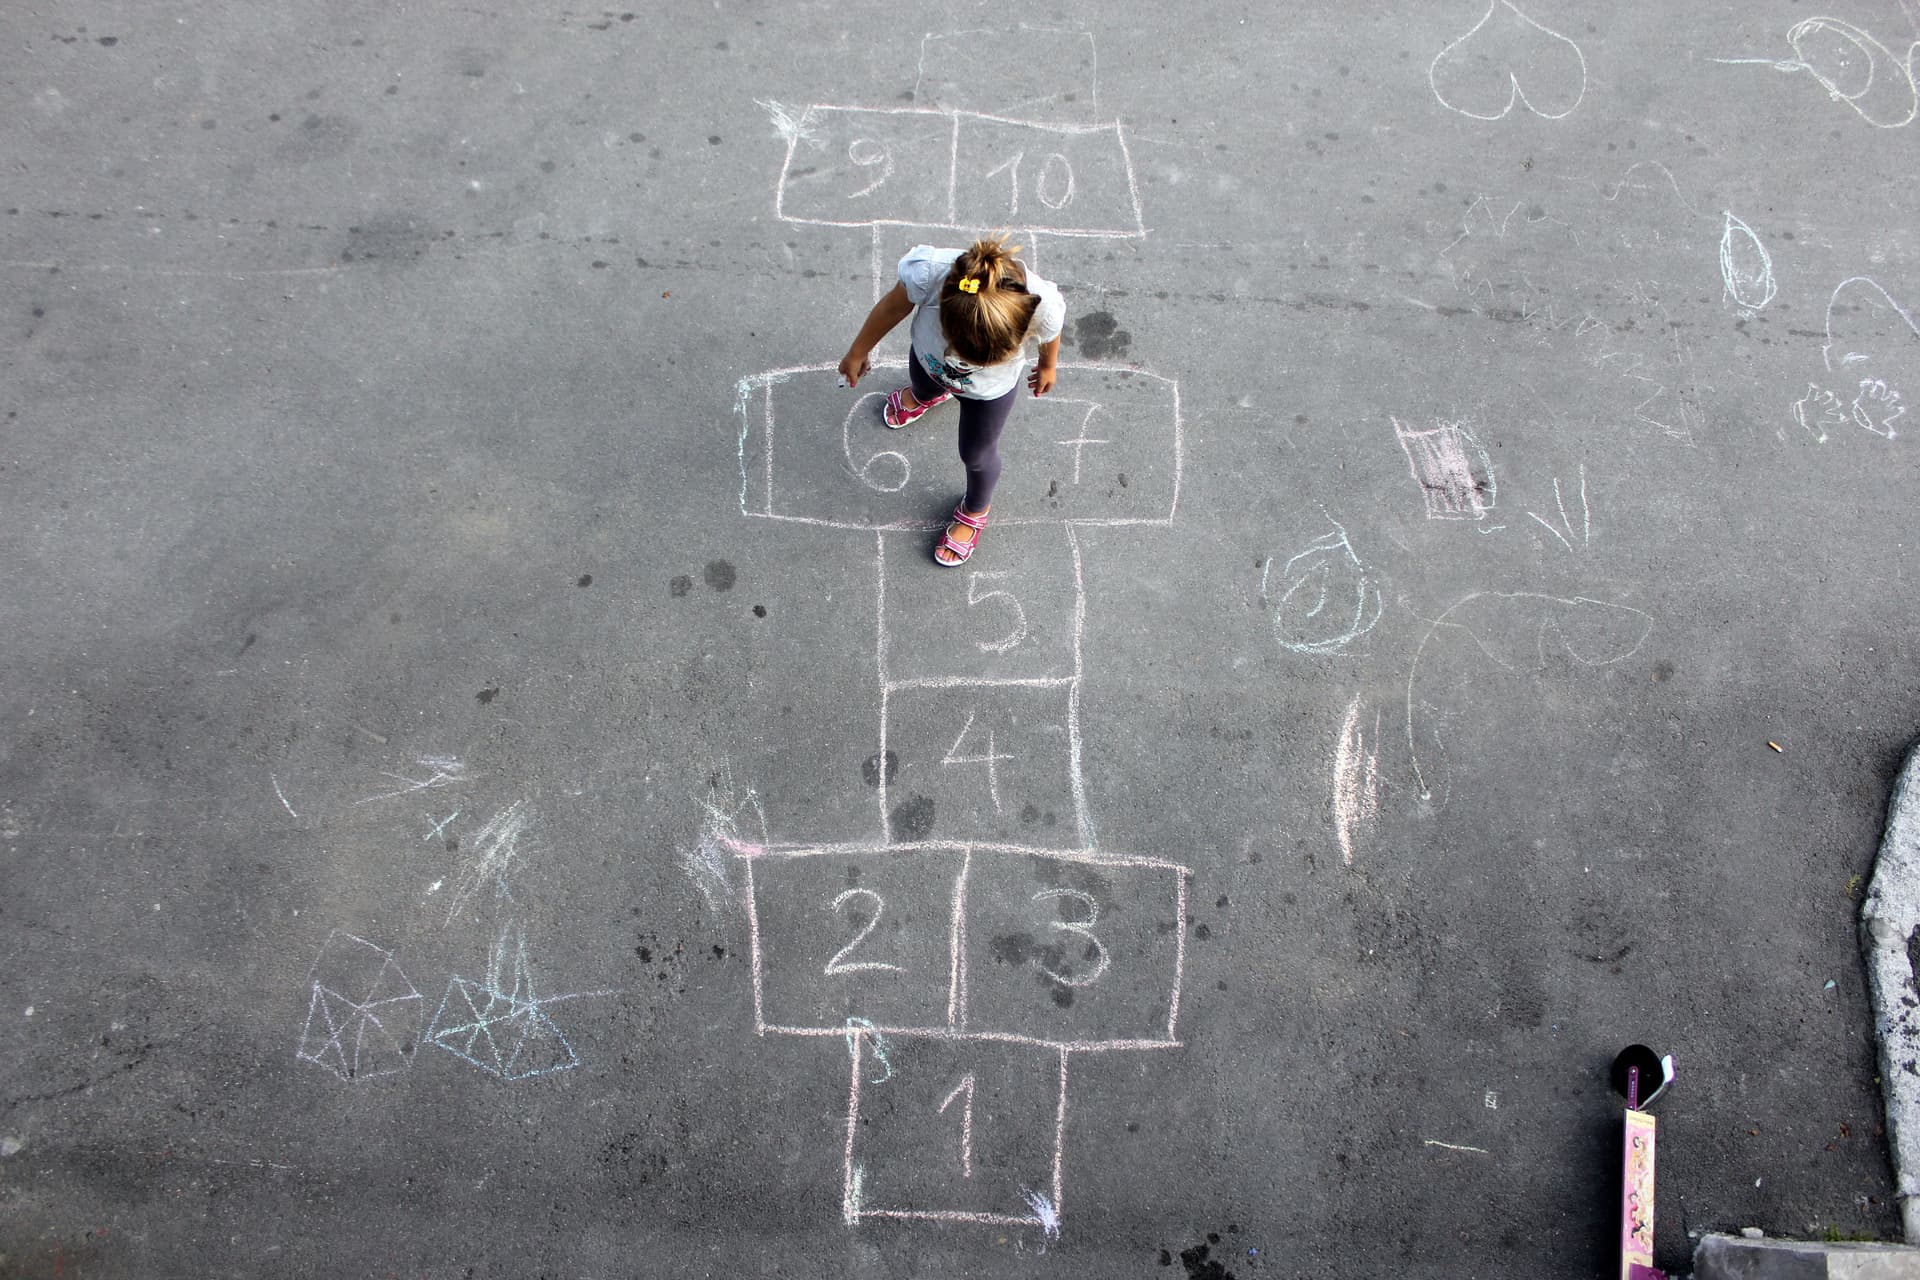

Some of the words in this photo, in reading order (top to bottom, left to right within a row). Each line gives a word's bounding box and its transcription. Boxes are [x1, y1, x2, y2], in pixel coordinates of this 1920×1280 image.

[848, 138, 895, 199] 9
[986, 152, 1074, 216] 10
[843, 391, 911, 493] 6
[1027, 395, 1109, 485] 7
[968, 571, 1027, 653] 5
[941, 710, 1015, 815] 4
[824, 888, 905, 975] 2
[1032, 888, 1110, 987] 3
[937, 1071, 976, 1178] 1
